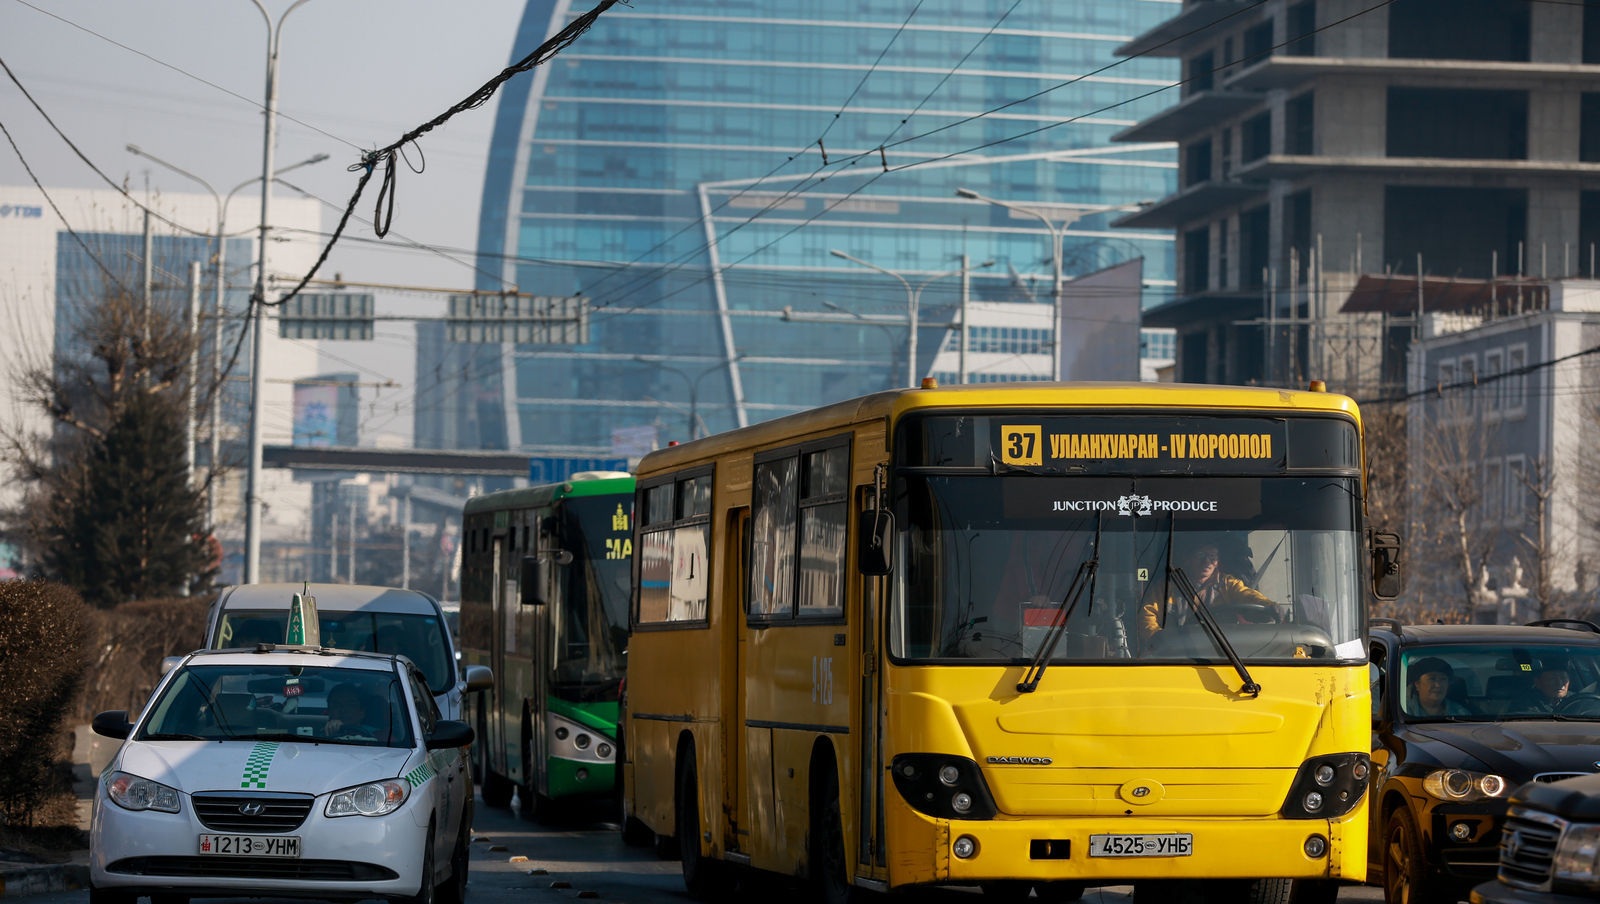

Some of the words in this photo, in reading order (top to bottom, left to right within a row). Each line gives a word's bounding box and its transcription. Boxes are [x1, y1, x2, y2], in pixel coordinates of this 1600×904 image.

[1007, 432, 1036, 459] 37
[1050, 433, 1159, 459] УЛААНХУАРАН
[1170, 433, 1187, 459] IV
[1189, 433, 1272, 459] ХОРООЛОЛ
[1052, 500, 1116, 512] JUNCTION
[1153, 500, 1218, 512] PRODUCE
[1139, 569, 1147, 579] 4
[292, 605, 301, 642] TAXI
[987, 756, 1053, 765] DAEWOO
[213, 836, 253, 854] 1213
[265, 838, 297, 855] УНМ
[1102, 837, 1144, 854] 4525
[1157, 837, 1188, 853] УНБ
